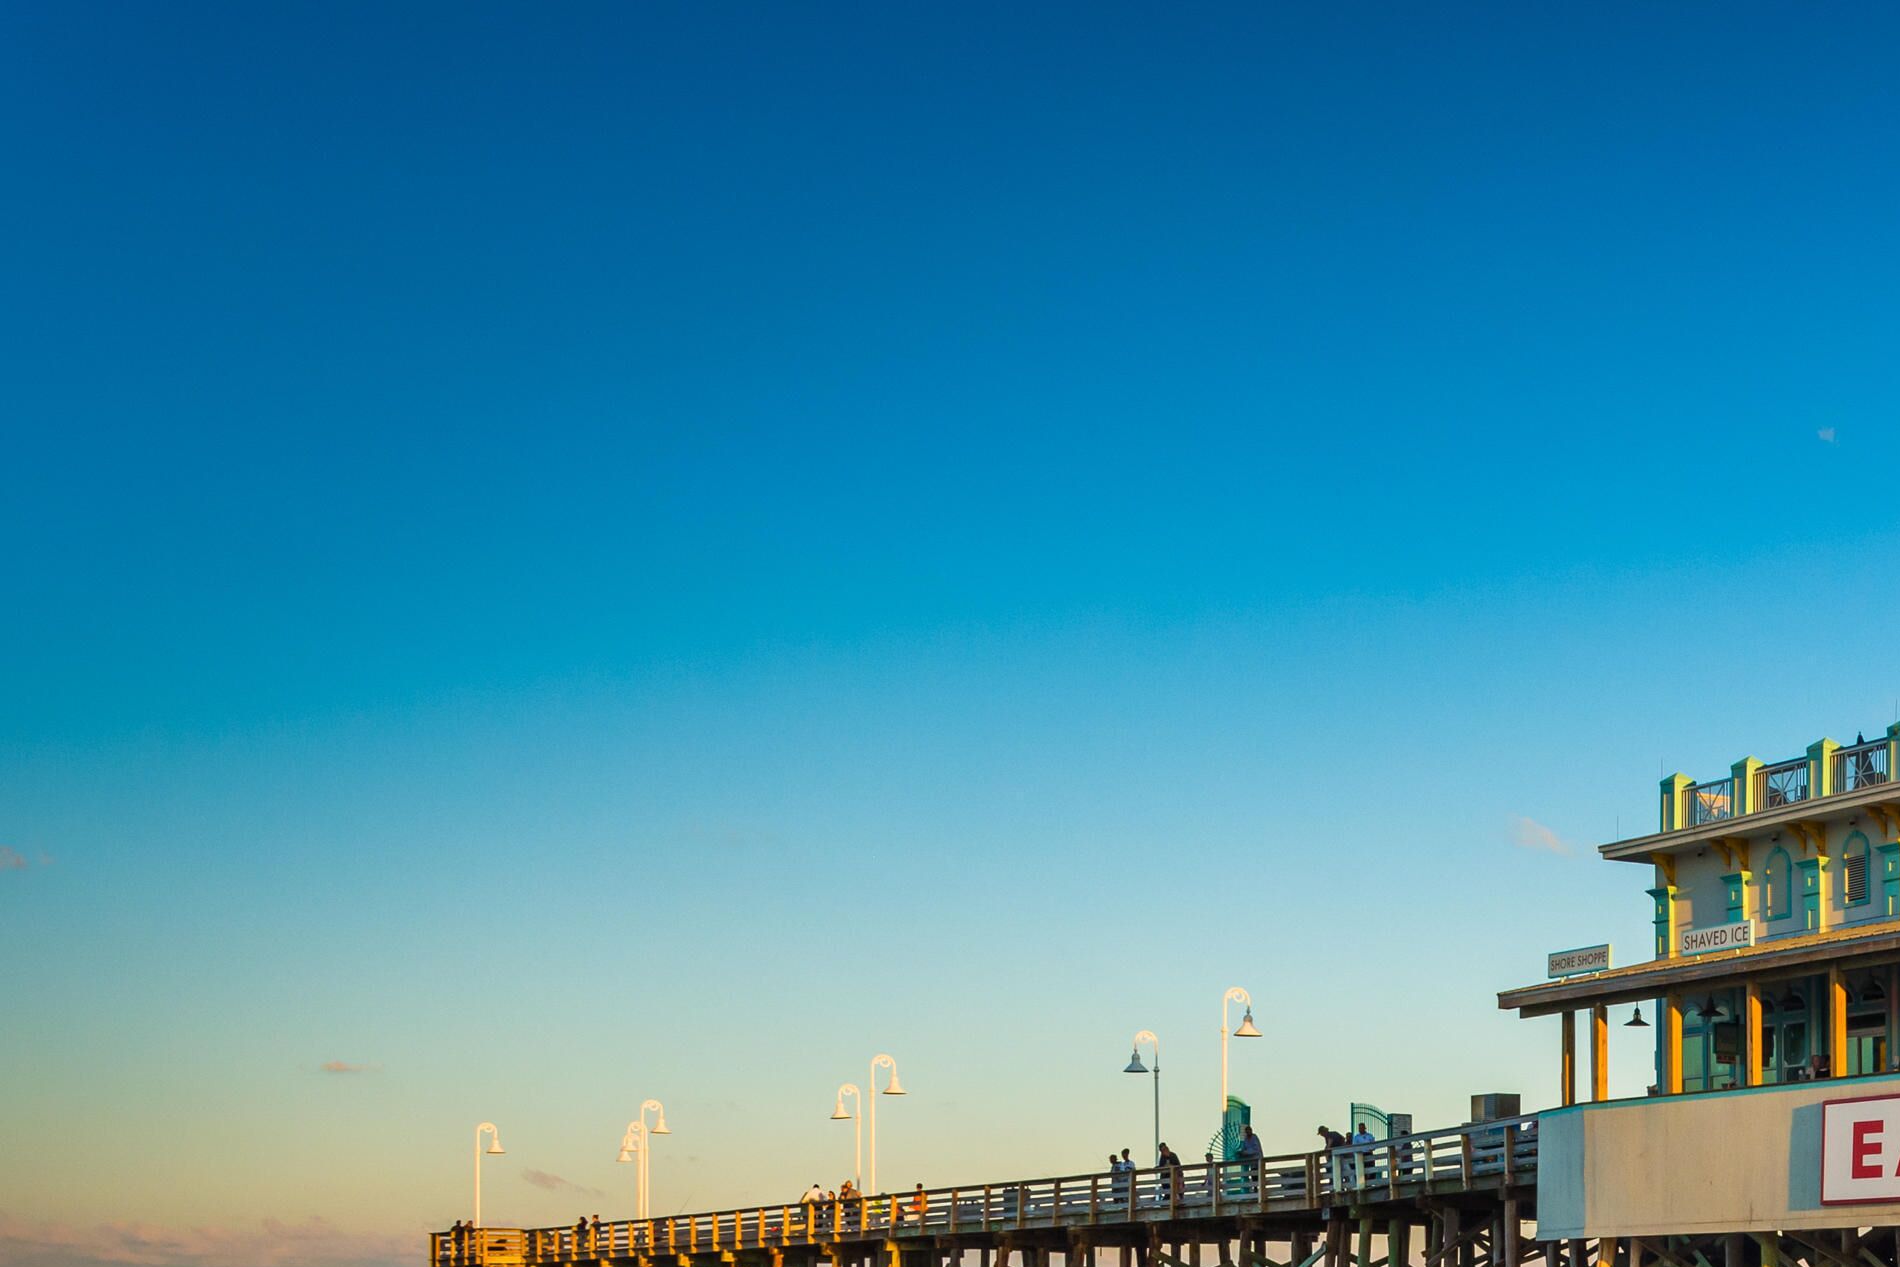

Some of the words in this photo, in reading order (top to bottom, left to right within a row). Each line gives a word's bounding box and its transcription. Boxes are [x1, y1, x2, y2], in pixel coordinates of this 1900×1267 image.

[1684, 929, 1727, 950] SHAVED
[1731, 925, 1748, 943] ICE
[1551, 957, 1576, 971] SHORE
[1577, 951, 1607, 967] SHOPPE
